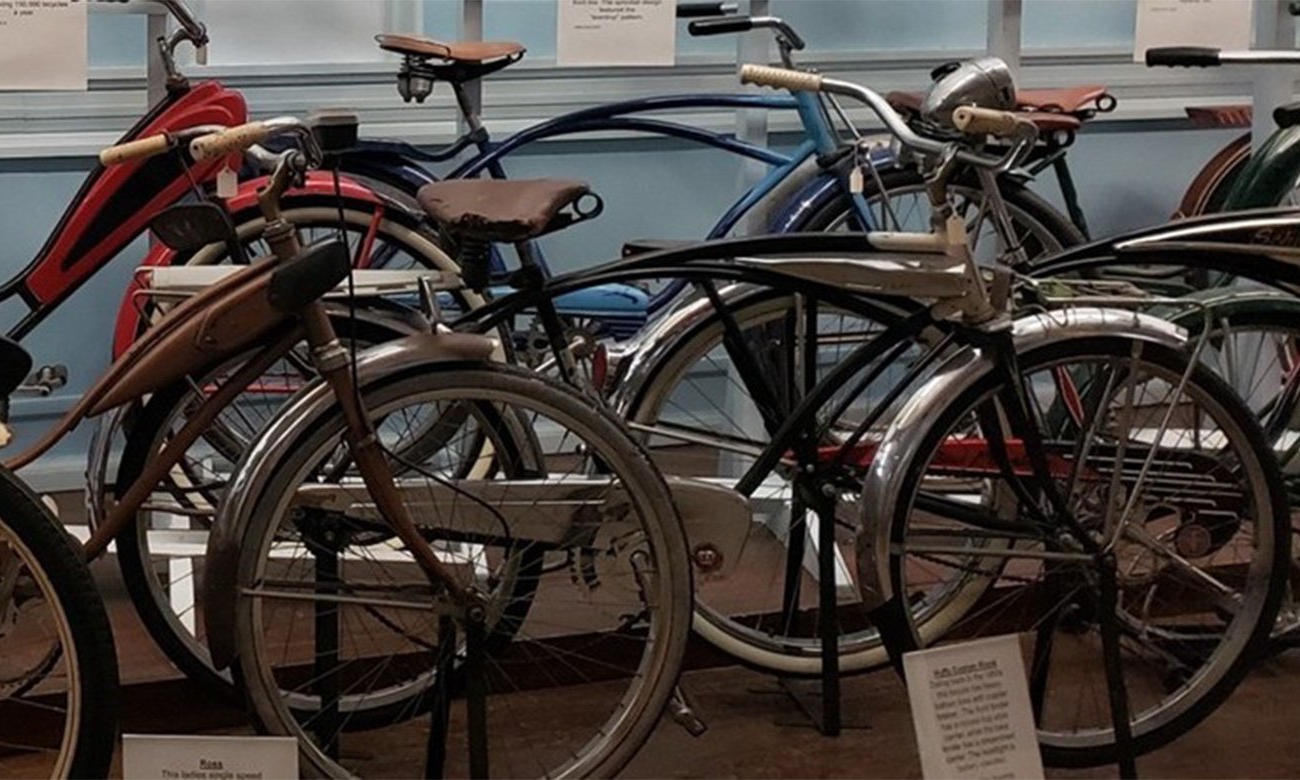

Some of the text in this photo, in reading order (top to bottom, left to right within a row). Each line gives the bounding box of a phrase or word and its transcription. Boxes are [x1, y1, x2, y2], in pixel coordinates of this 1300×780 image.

[200, 759, 223, 770] Ross
[162, 771, 180, 779] This
[209, 771, 234, 780] single
[236, 771, 261, 780] speed
